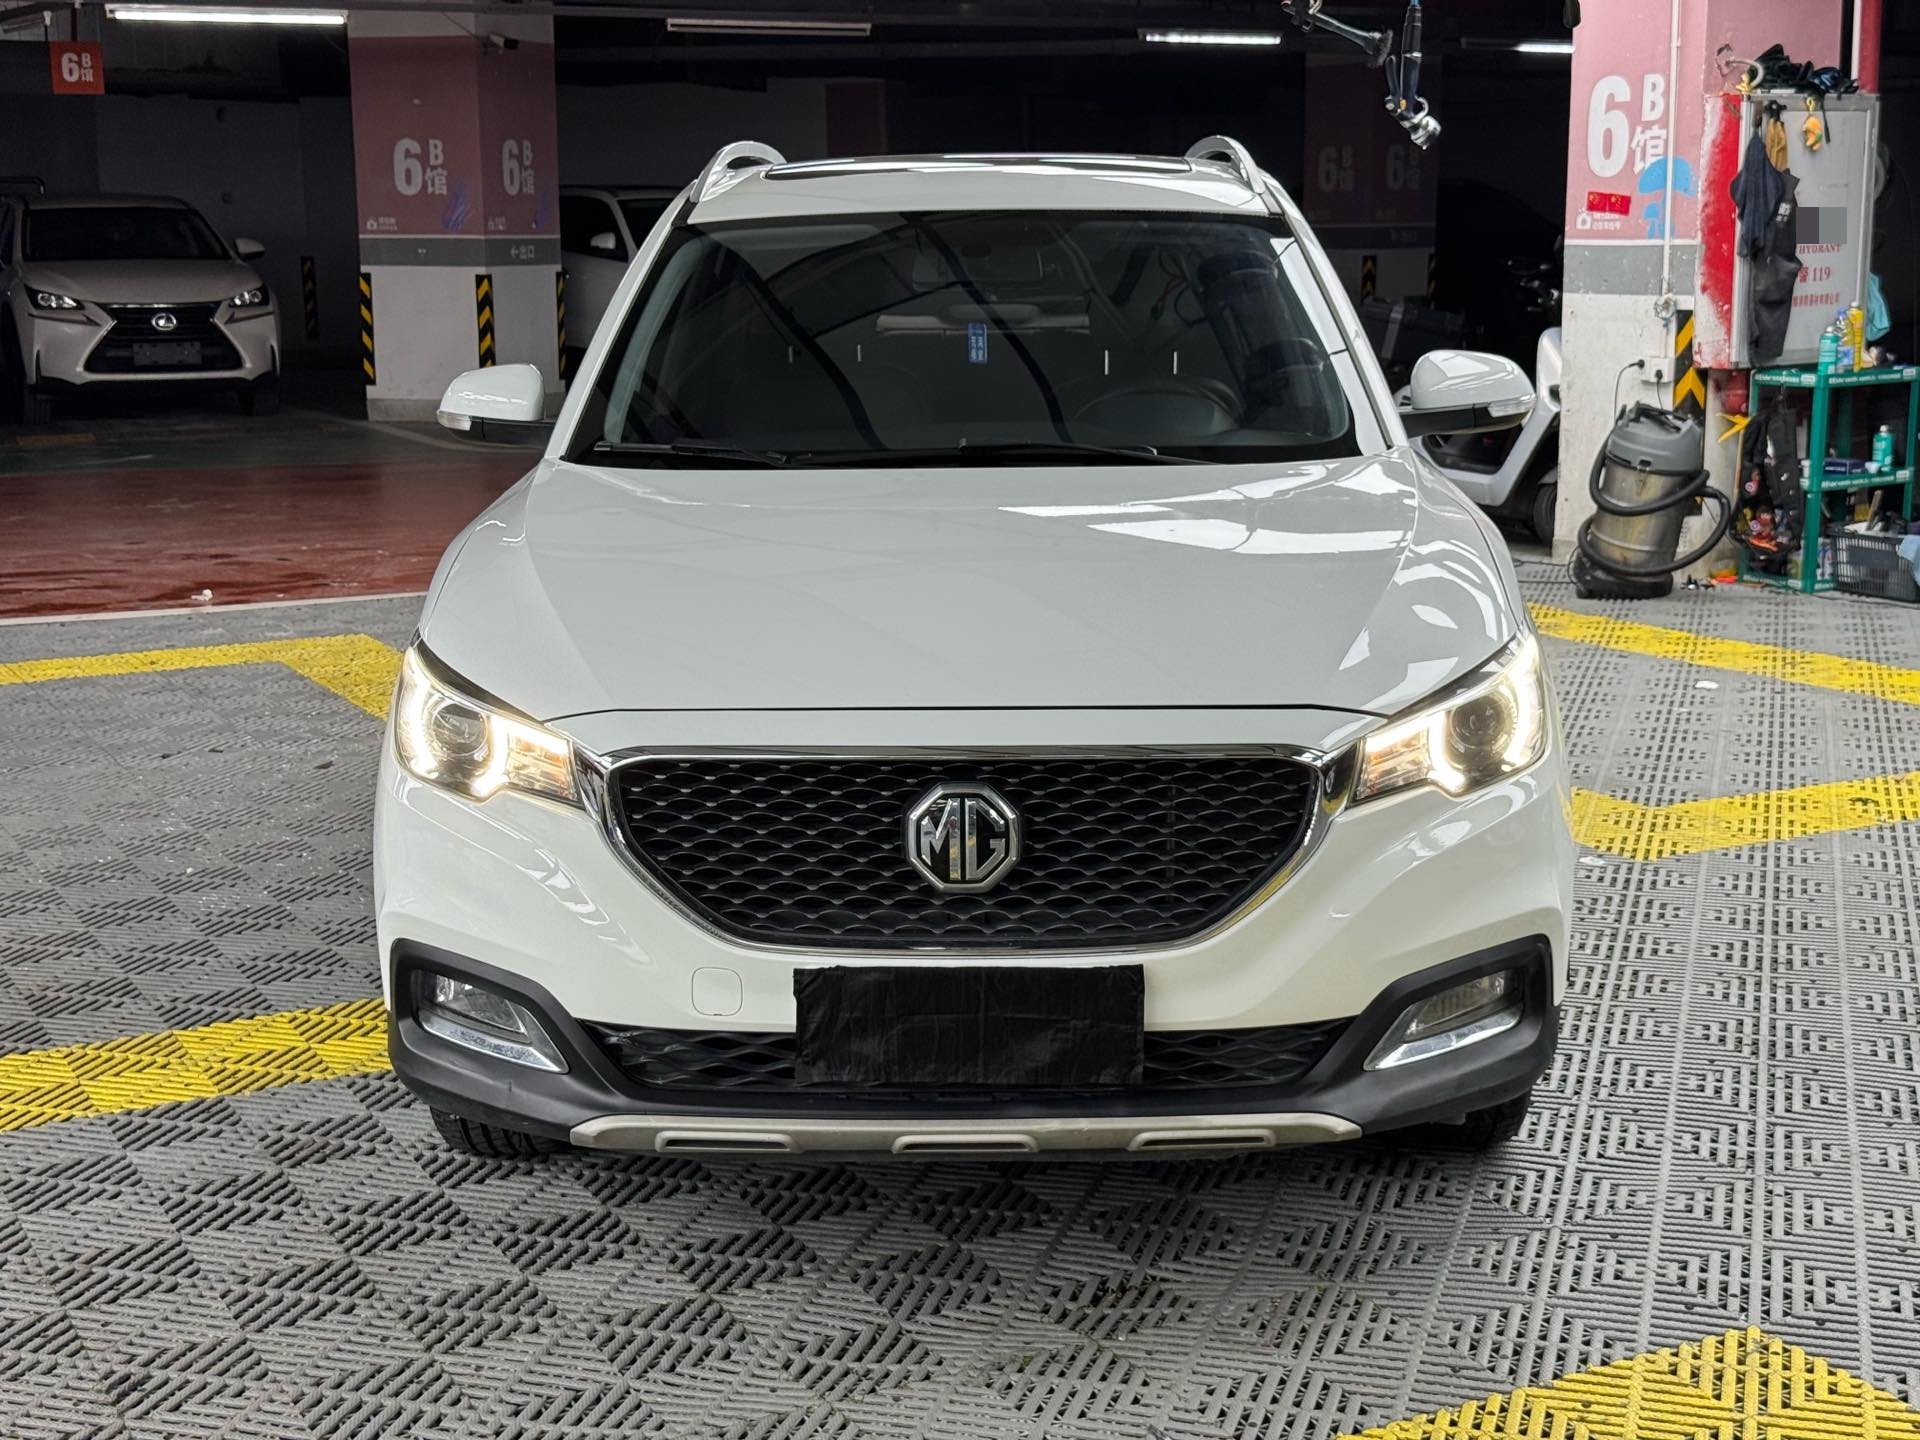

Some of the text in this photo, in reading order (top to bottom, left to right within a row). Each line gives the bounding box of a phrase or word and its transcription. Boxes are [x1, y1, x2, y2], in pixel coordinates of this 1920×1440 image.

[62, 53, 80, 83] 6
[81, 53, 91, 67] B
[1641, 74, 1664, 122] B
[1587, 75, 1631, 178] 6
[393, 137, 423, 196] 6
[428, 139, 444, 166] B
[502, 139, 521, 196] 6
[522, 140, 533, 166] B
[1386, 144, 1405, 190] 6
[1631, 125, 1667, 174] 馆
[424, 167, 448, 195] 馆
[521, 168, 535, 195] 馆
[1318, 146, 1337, 191] 6
[1799, 244, 1841, 254] HYDRANT
[1812, 267, 1831, 282] 119
[920, 797, 1006, 881] MG
